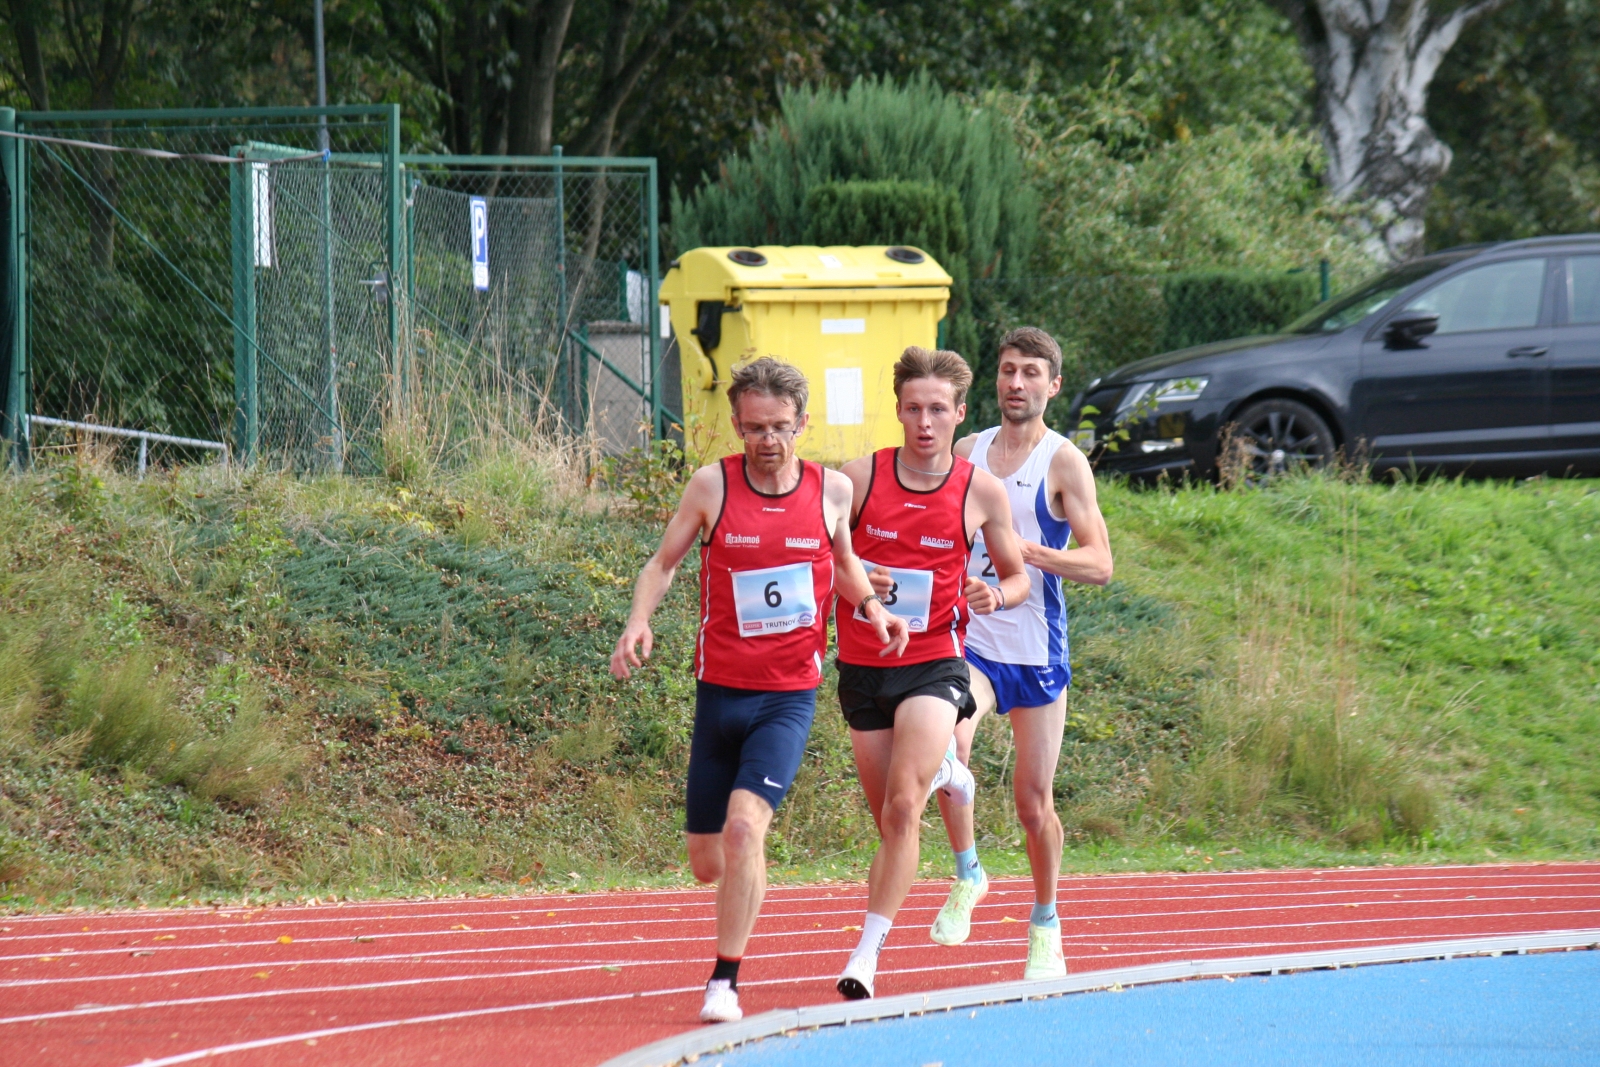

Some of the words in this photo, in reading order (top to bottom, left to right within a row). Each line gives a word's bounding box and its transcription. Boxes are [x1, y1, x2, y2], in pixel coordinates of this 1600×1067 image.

[475, 206, 485, 257] P
[785, 537, 820, 545] MARATON
[921, 536, 954, 546] MARATON
[982, 553, 995, 577] 2
[764, 581, 782, 608] 6
[765, 618, 796, 628] TRUTNOV
